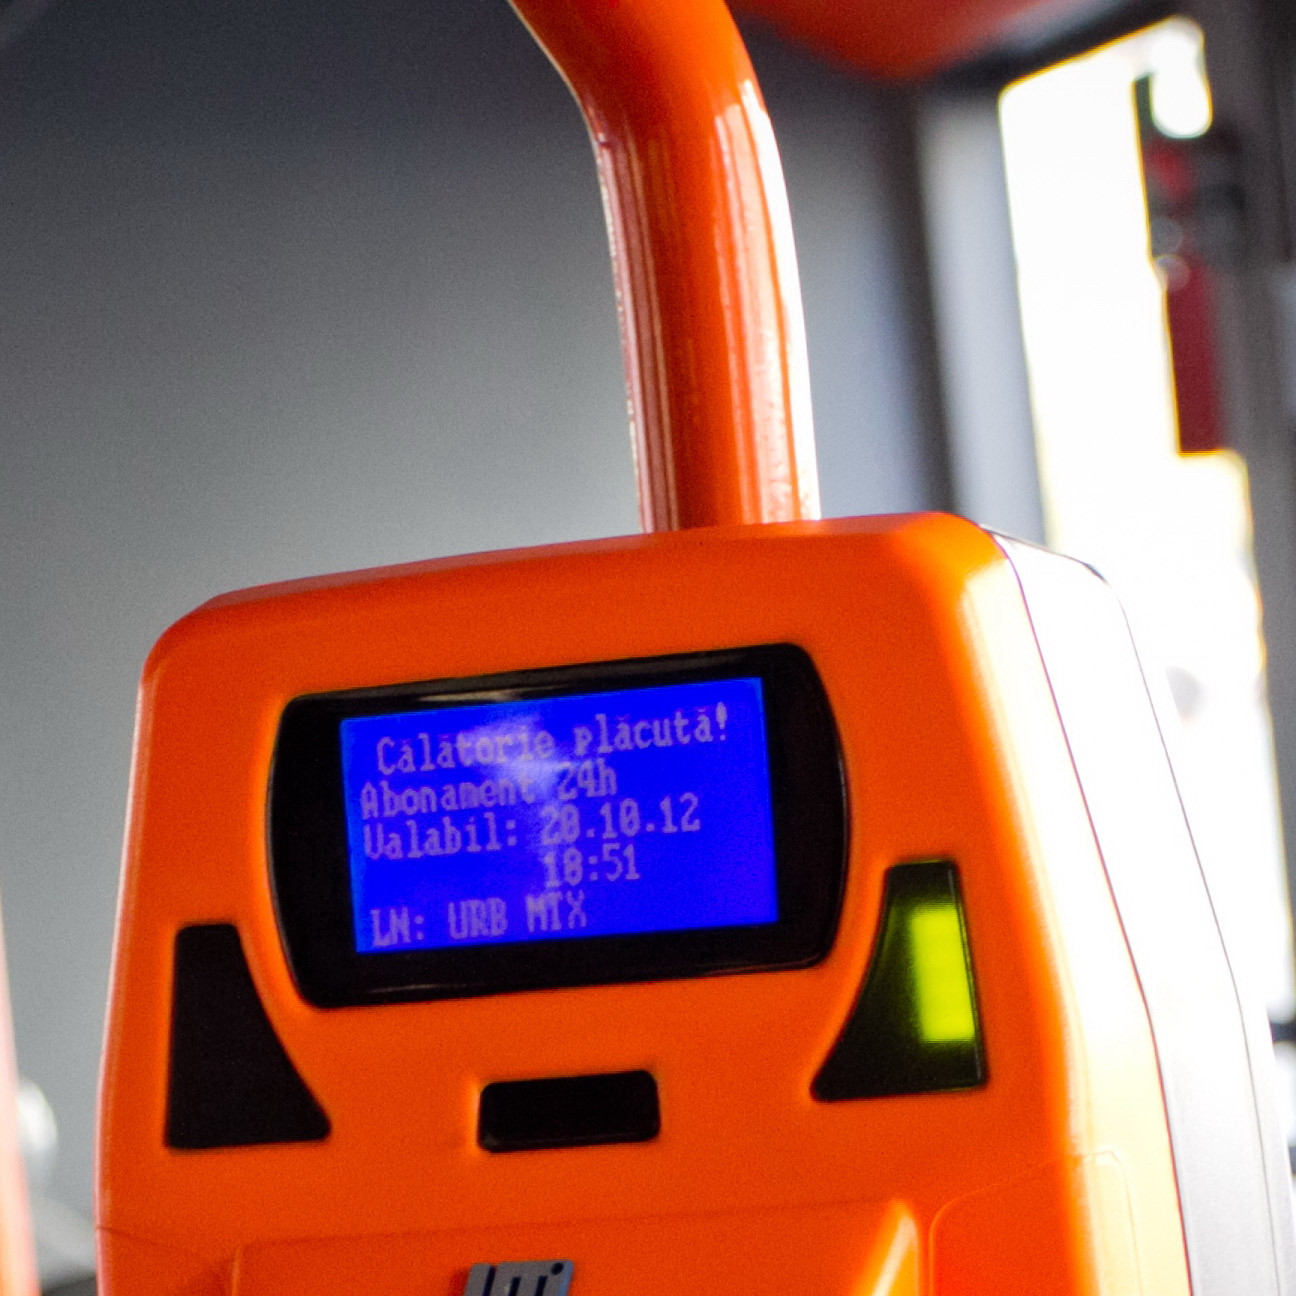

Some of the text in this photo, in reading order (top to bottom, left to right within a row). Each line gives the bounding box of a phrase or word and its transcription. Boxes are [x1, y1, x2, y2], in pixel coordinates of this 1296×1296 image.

[573, 701, 728, 756] plăcută!
[360, 758, 618, 820] Abonament 24h
[544, 843, 640, 888] 18:51
[448, 897, 508, 940] URB
